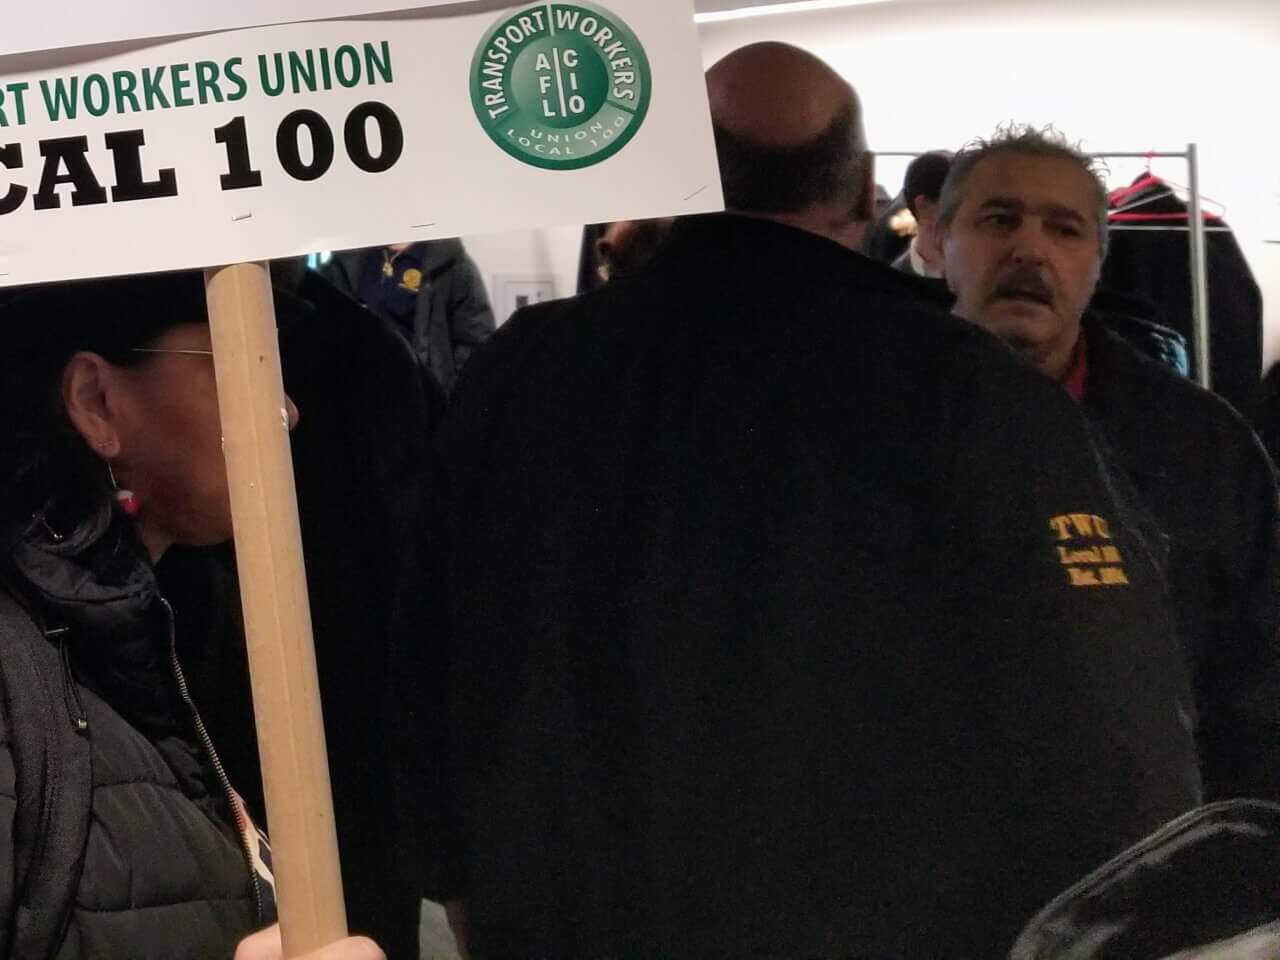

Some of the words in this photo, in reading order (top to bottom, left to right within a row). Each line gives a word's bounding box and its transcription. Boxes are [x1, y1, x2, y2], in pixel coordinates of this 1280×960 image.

[38, 57, 248, 122] WORKERS
[257, 40, 393, 97] UNION
[482, 10, 545, 119] TRANSPORT
[556, 9, 637, 102] WORKERS
[213, 100, 404, 191] 100
[506, 128, 577, 156] LOCAL
[589, 116, 626, 147] 100
[530, 122, 603, 144] UNION
